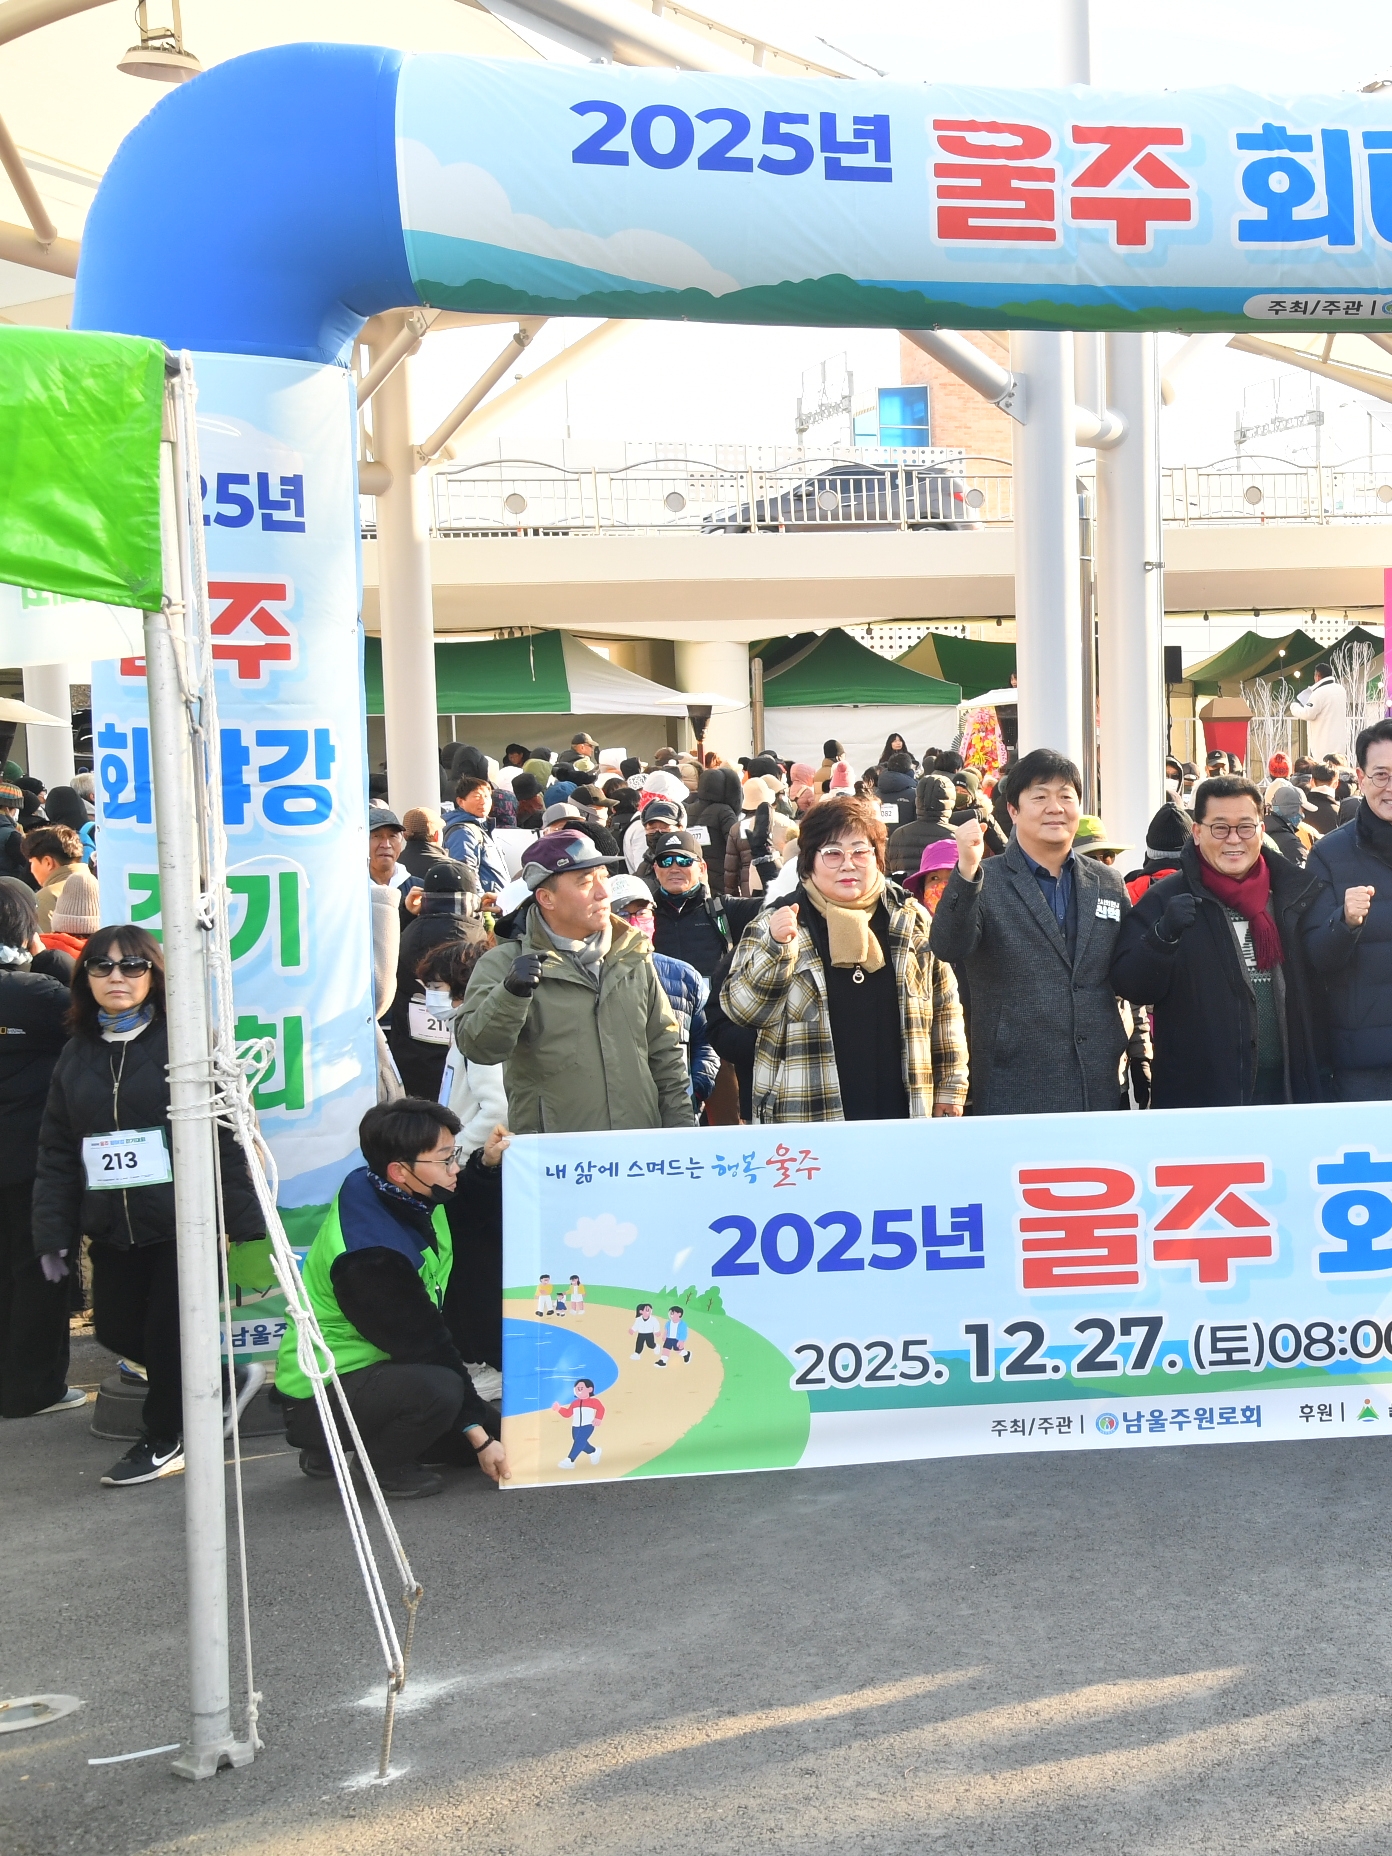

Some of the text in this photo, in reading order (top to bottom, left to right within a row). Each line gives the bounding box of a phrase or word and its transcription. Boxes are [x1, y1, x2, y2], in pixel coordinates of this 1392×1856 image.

[569, 99, 893, 182] 2025년
[932, 118, 1192, 246] 울주
[1267, 300, 1363, 316] 주최/주관
[101, 1151, 138, 1171] 213
[545, 1143, 822, 1188] 내 삶에 스며드는 행복 울주
[708, 1204, 985, 1276] 2025년
[1018, 1161, 1273, 1289] 울주
[794, 1340, 946, 1385] 2025.
[991, 1416, 1073, 1437] 주최/주관
[1122, 1405, 1263, 1434] 남울주원로회
[1298, 1403, 1334, 1423] 후원
